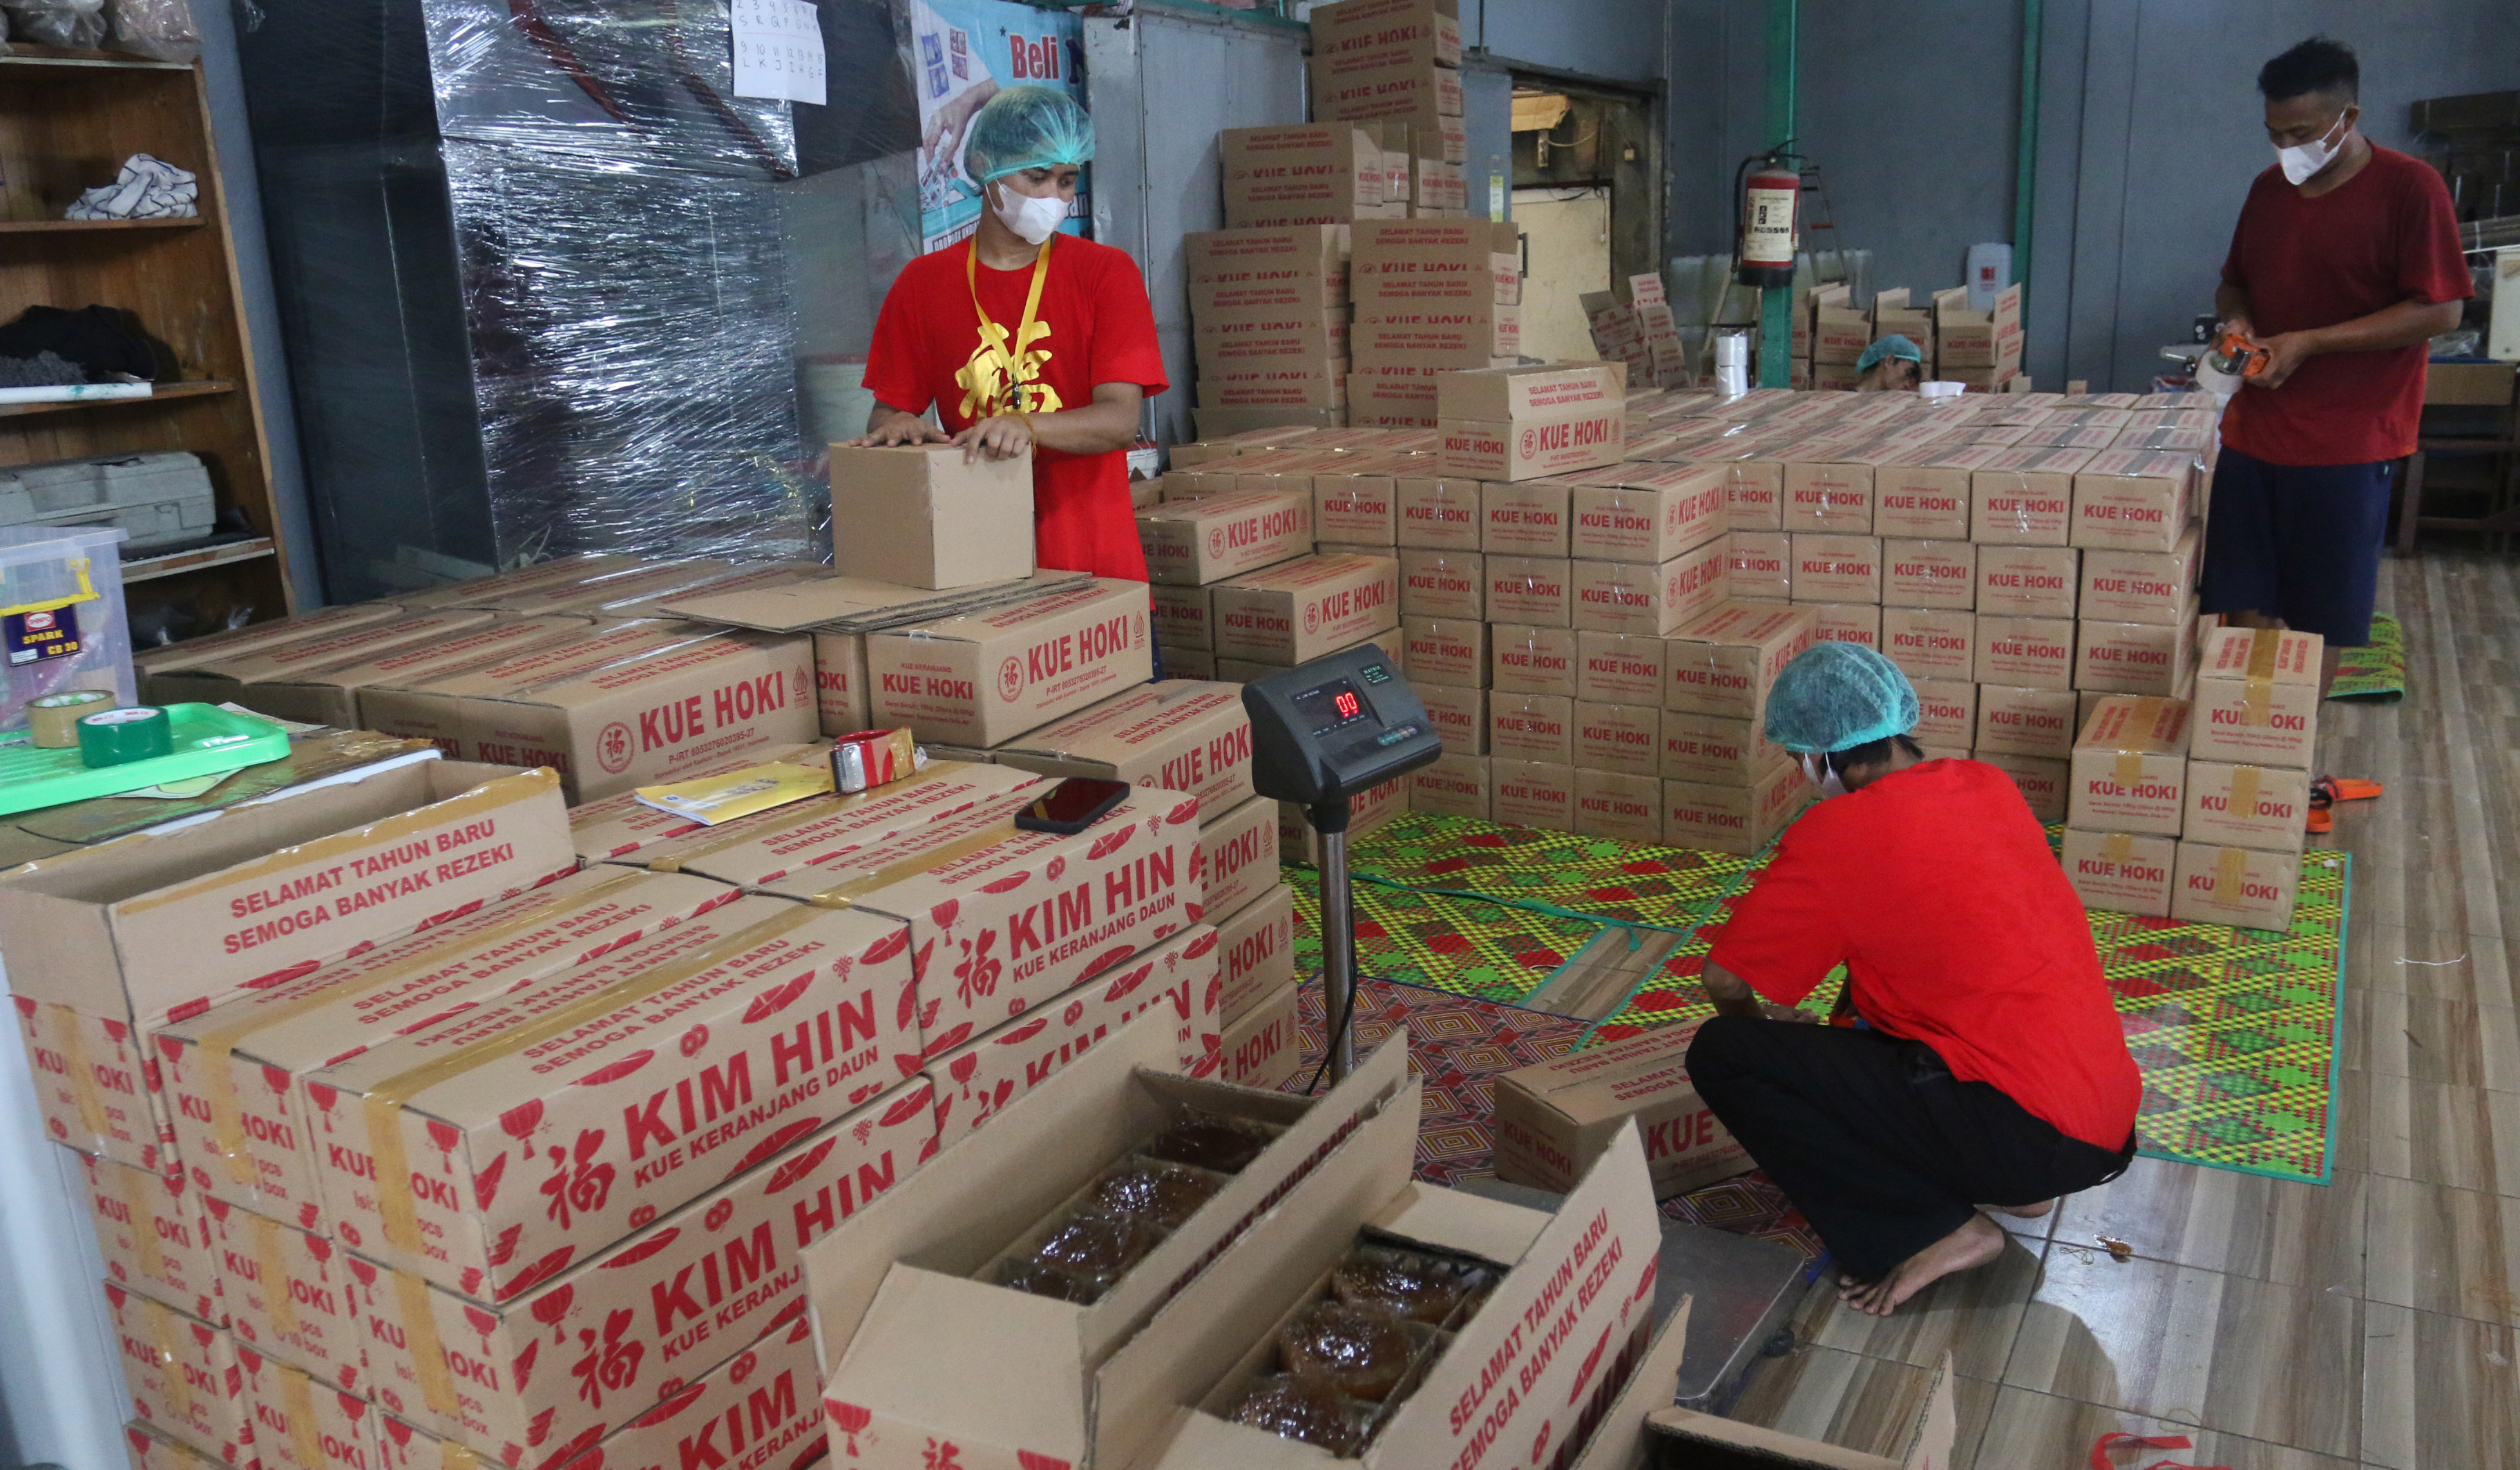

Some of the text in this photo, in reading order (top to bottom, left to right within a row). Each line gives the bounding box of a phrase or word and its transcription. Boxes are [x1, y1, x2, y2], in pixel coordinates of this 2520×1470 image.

[770, 1, 775, 12] 4
[740, 16, 788, 28] S R Q P
[741, 41, 747, 52] 9
[756, 44, 765, 55] 10
[774, 47, 779, 56] 11
[787, 47, 794, 58] 12
[1010, 35, 1059, 79] Beli
[743, 59, 750, 67] L
[759, 59, 766, 68] K
[775, 60, 781, 70] J
[1529, 381, 1596, 394] SELAMAT TAHUN BARU
[1529, 392, 1604, 407] SEMOGA BANYAK REZEKI
[1445, 438, 1504, 454] KUE HOKI
[1540, 419, 1608, 451] KUE HOKI
[1325, 499, 1386, 515] KUE HOKI
[1491, 510, 1558, 526] KUE HOKI
[2084, 504, 2163, 523] KUE HOKI
[1228, 508, 1297, 549] KUE HOKI
[1988, 573, 2063, 590] KUE HOKI
[1322, 580, 1384, 623] KUE HOKI
[23, 630, 64, 644] SPARK
[48, 642, 78, 655] CB 30
[1029, 615, 1128, 685] KUE HOKI
[915, 664, 952, 673] KERANJANG
[1363, 665, 1382, 674] MATRIX
[2089, 647, 2167, 666] KUE HOKI
[591, 662, 653, 685] SELAMAT
[599, 674, 658, 689] SEMOGA
[817, 671, 847, 691] OKI
[883, 673, 973, 700] KUE HOKI
[1004, 662, 1018, 687] 福
[1677, 669, 1747, 689] KUE HOKI
[640, 671, 785, 752] KUE HOKI
[669, 750, 689, 764] P-IRT
[1162, 747, 1203, 791] KUE
[2089, 781, 2177, 800] KUE HOKI
[761, 817, 844, 846] SELAMAT
[842, 796, 904, 818] TAHUN
[901, 781, 948, 799] BARU
[770, 783, 977, 855] SEMOGA BANYAK REZEKI
[1674, 808, 1744, 828] KUE HOKI
[229, 818, 497, 920] SELAMAT TAHUN BARU
[1215, 826, 1257, 884] HOKI
[2079, 859, 2164, 882] KUE HOKI
[222, 842, 514, 956] SEMOGA BANYAK REZEKI
[1009, 882, 1092, 961] KIM
[1105, 845, 1174, 917] HIN
[1013, 959, 1045, 984] KUE
[1049, 915, 1135, 966] KERANJANG
[1140, 892, 1174, 922] DAUN
[1229, 922, 1274, 984] HOKI
[954, 928, 1002, 1009] 福
[523, 940, 790, 1058] SELAMAT TAHUN BARU
[531, 941, 825, 1073] SEMOGA BANYAK REZEKI
[1236, 1019, 1281, 1082] HOKI
[622, 989, 878, 1161] KIM HIN
[1610, 1067, 1681, 1091] SELAMAT
[1614, 1079, 1679, 1100] SEMOGA
[178, 1093, 211, 1123] KU
[634, 1044, 879, 1189] KUE KERANJANG DAUN
[1505, 1119, 1572, 1175] KUE HOKI
[1648, 1109, 1714, 1161] KUE
[258, 1159, 283, 1176] pcs
[540, 1128, 616, 1230] 福
[263, 1176, 288, 1199] box
[411, 1172, 459, 1212] OKI
[417, 1218, 443, 1238] pcs
[651, 1149, 897, 1339] KIM HIN
[662, 1265, 804, 1364] KUE KERANJ
[1451, 1208, 1607, 1436] SELAMAT TAHUN BARU
[1520, 1236, 1623, 1396] BANYAK REZEKI
[571, 1308, 645, 1409] 福
